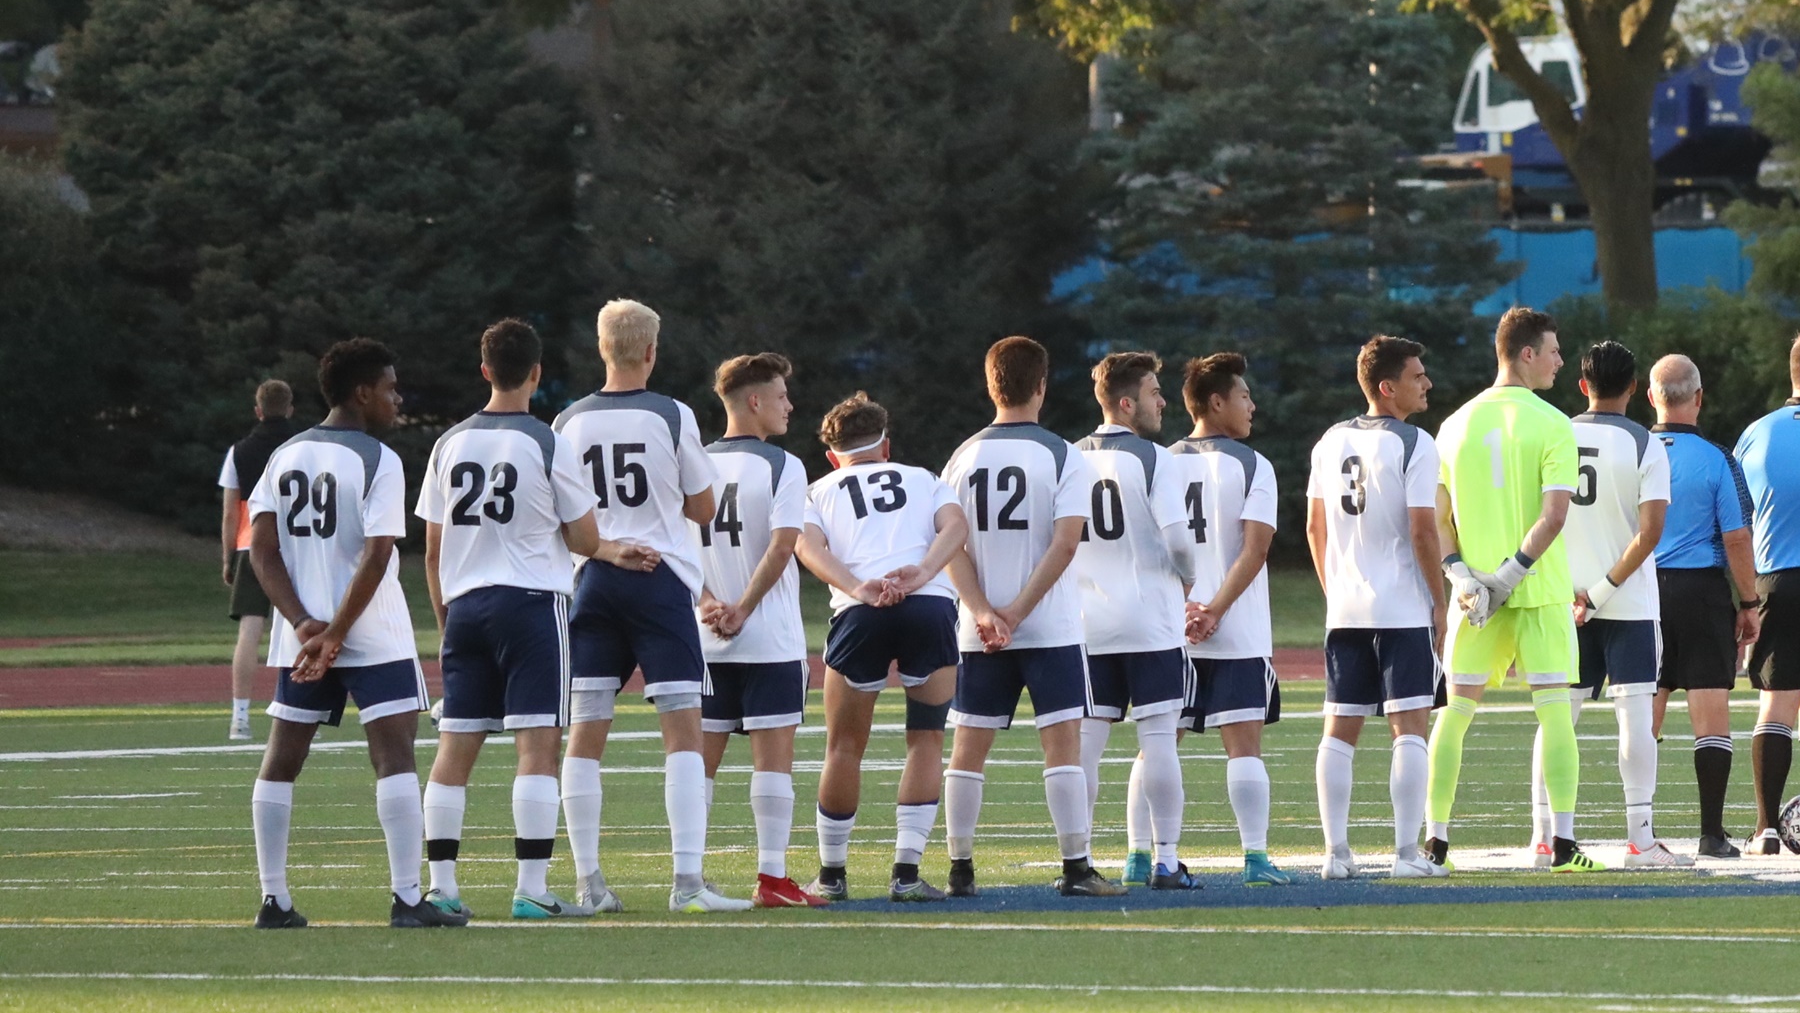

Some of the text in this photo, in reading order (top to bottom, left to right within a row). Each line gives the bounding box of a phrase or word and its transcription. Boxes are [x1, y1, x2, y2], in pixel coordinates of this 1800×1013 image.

[583, 443, 649, 509] 15
[1341, 456, 1367, 516] 3
[1483, 428, 1506, 488] 1
[1572, 447, 1600, 506] 5
[279, 470, 337, 539] 29
[450, 461, 518, 526] 23
[839, 469, 908, 520] 13
[969, 465, 1029, 532] 12
[1080, 478, 1125, 541] 0
